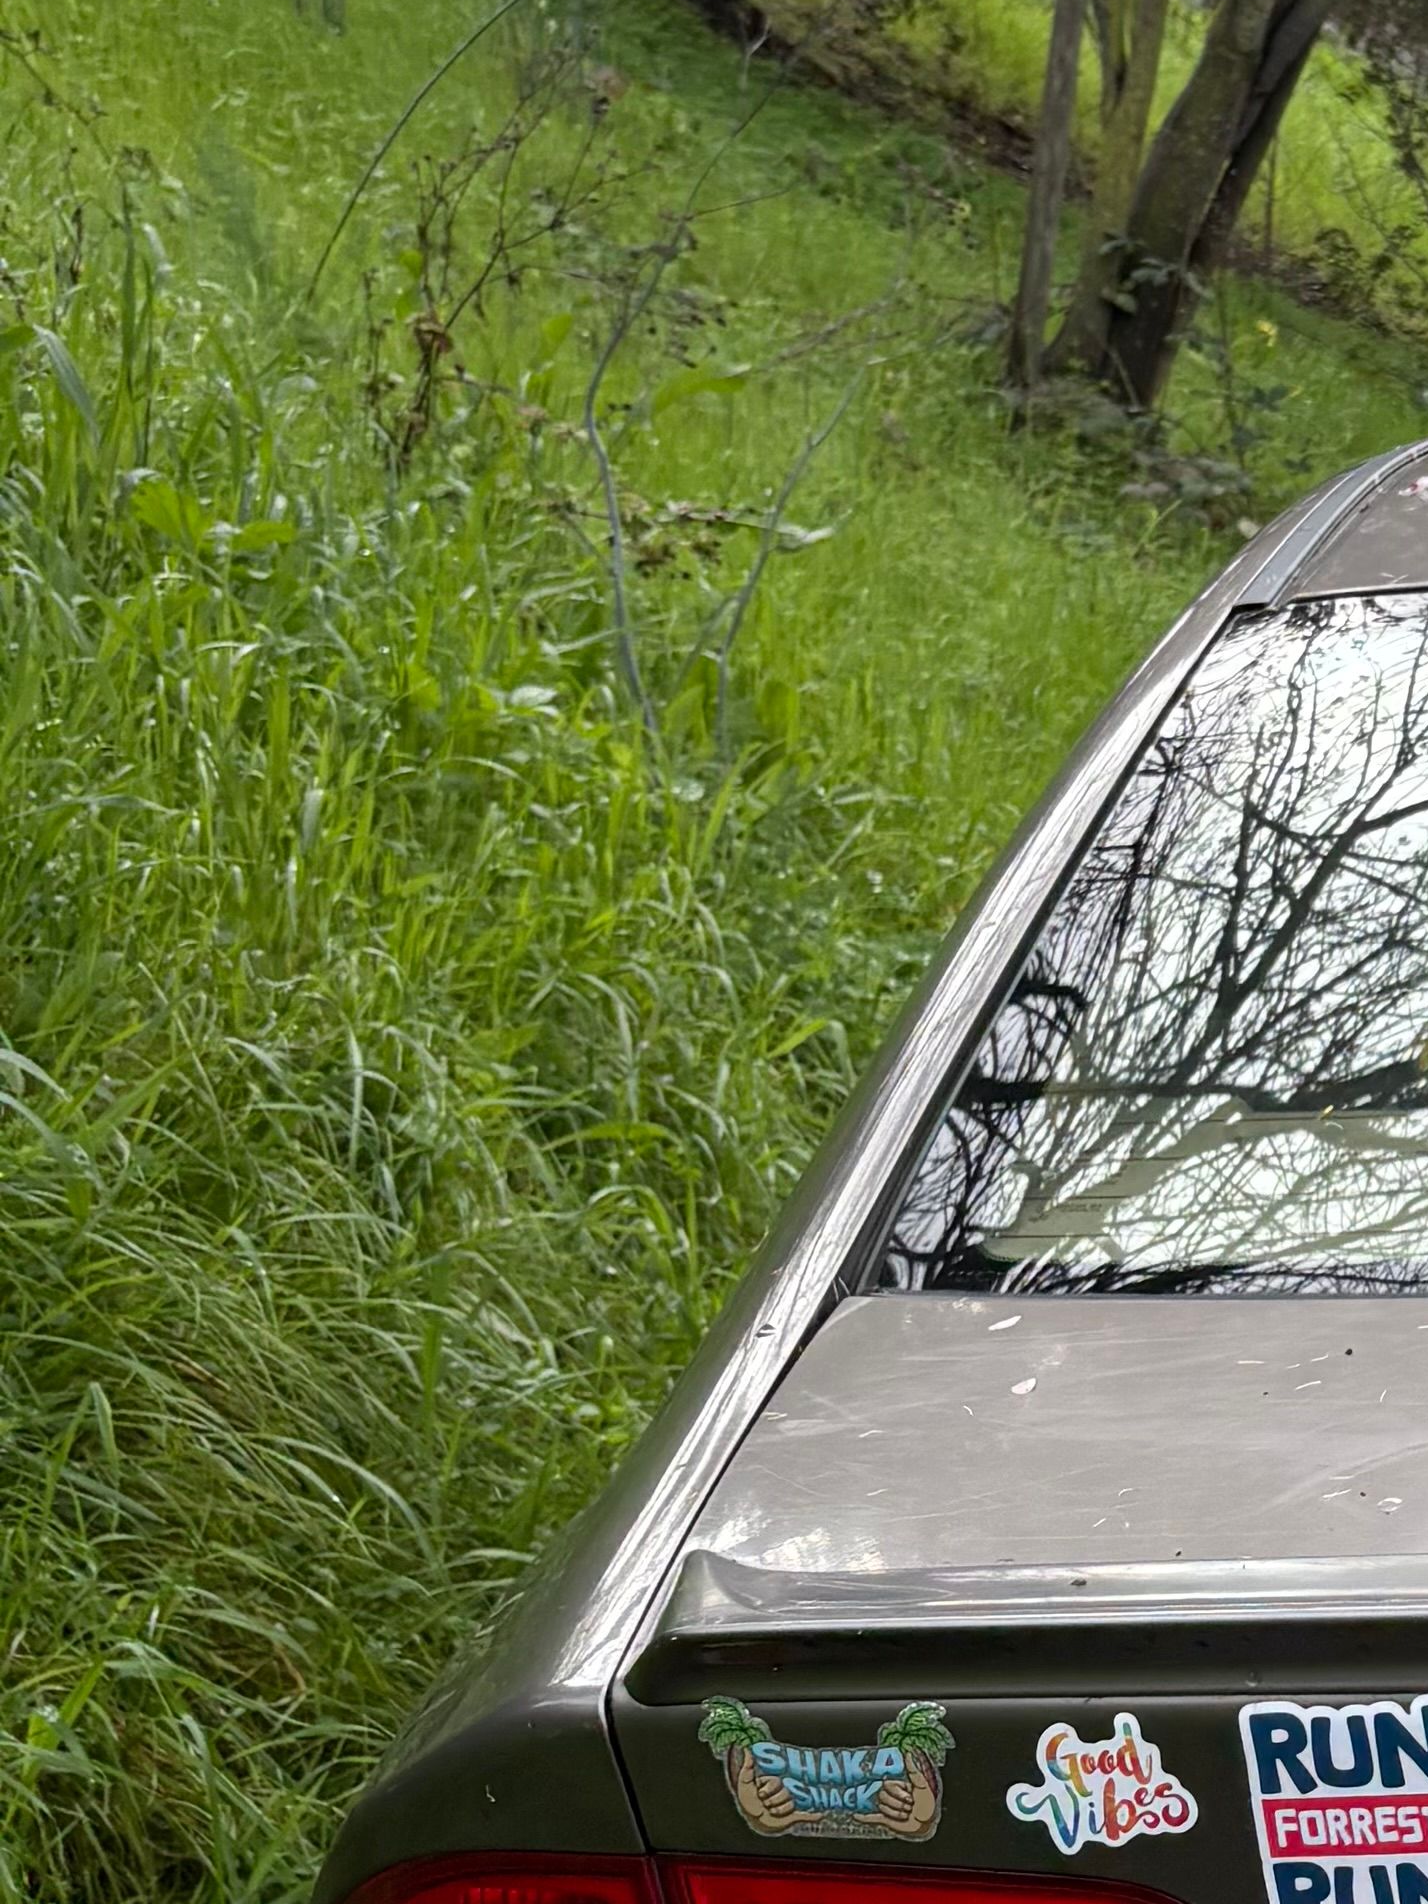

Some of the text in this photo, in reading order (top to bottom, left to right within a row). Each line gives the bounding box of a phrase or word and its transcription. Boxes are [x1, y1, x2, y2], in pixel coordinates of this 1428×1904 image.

[751, 1742, 906, 1784] SHAKA
[1045, 1722, 1153, 1798] Good
[783, 1777, 883, 1814] SHACK
[1015, 1777, 1190, 1848] Vibes
